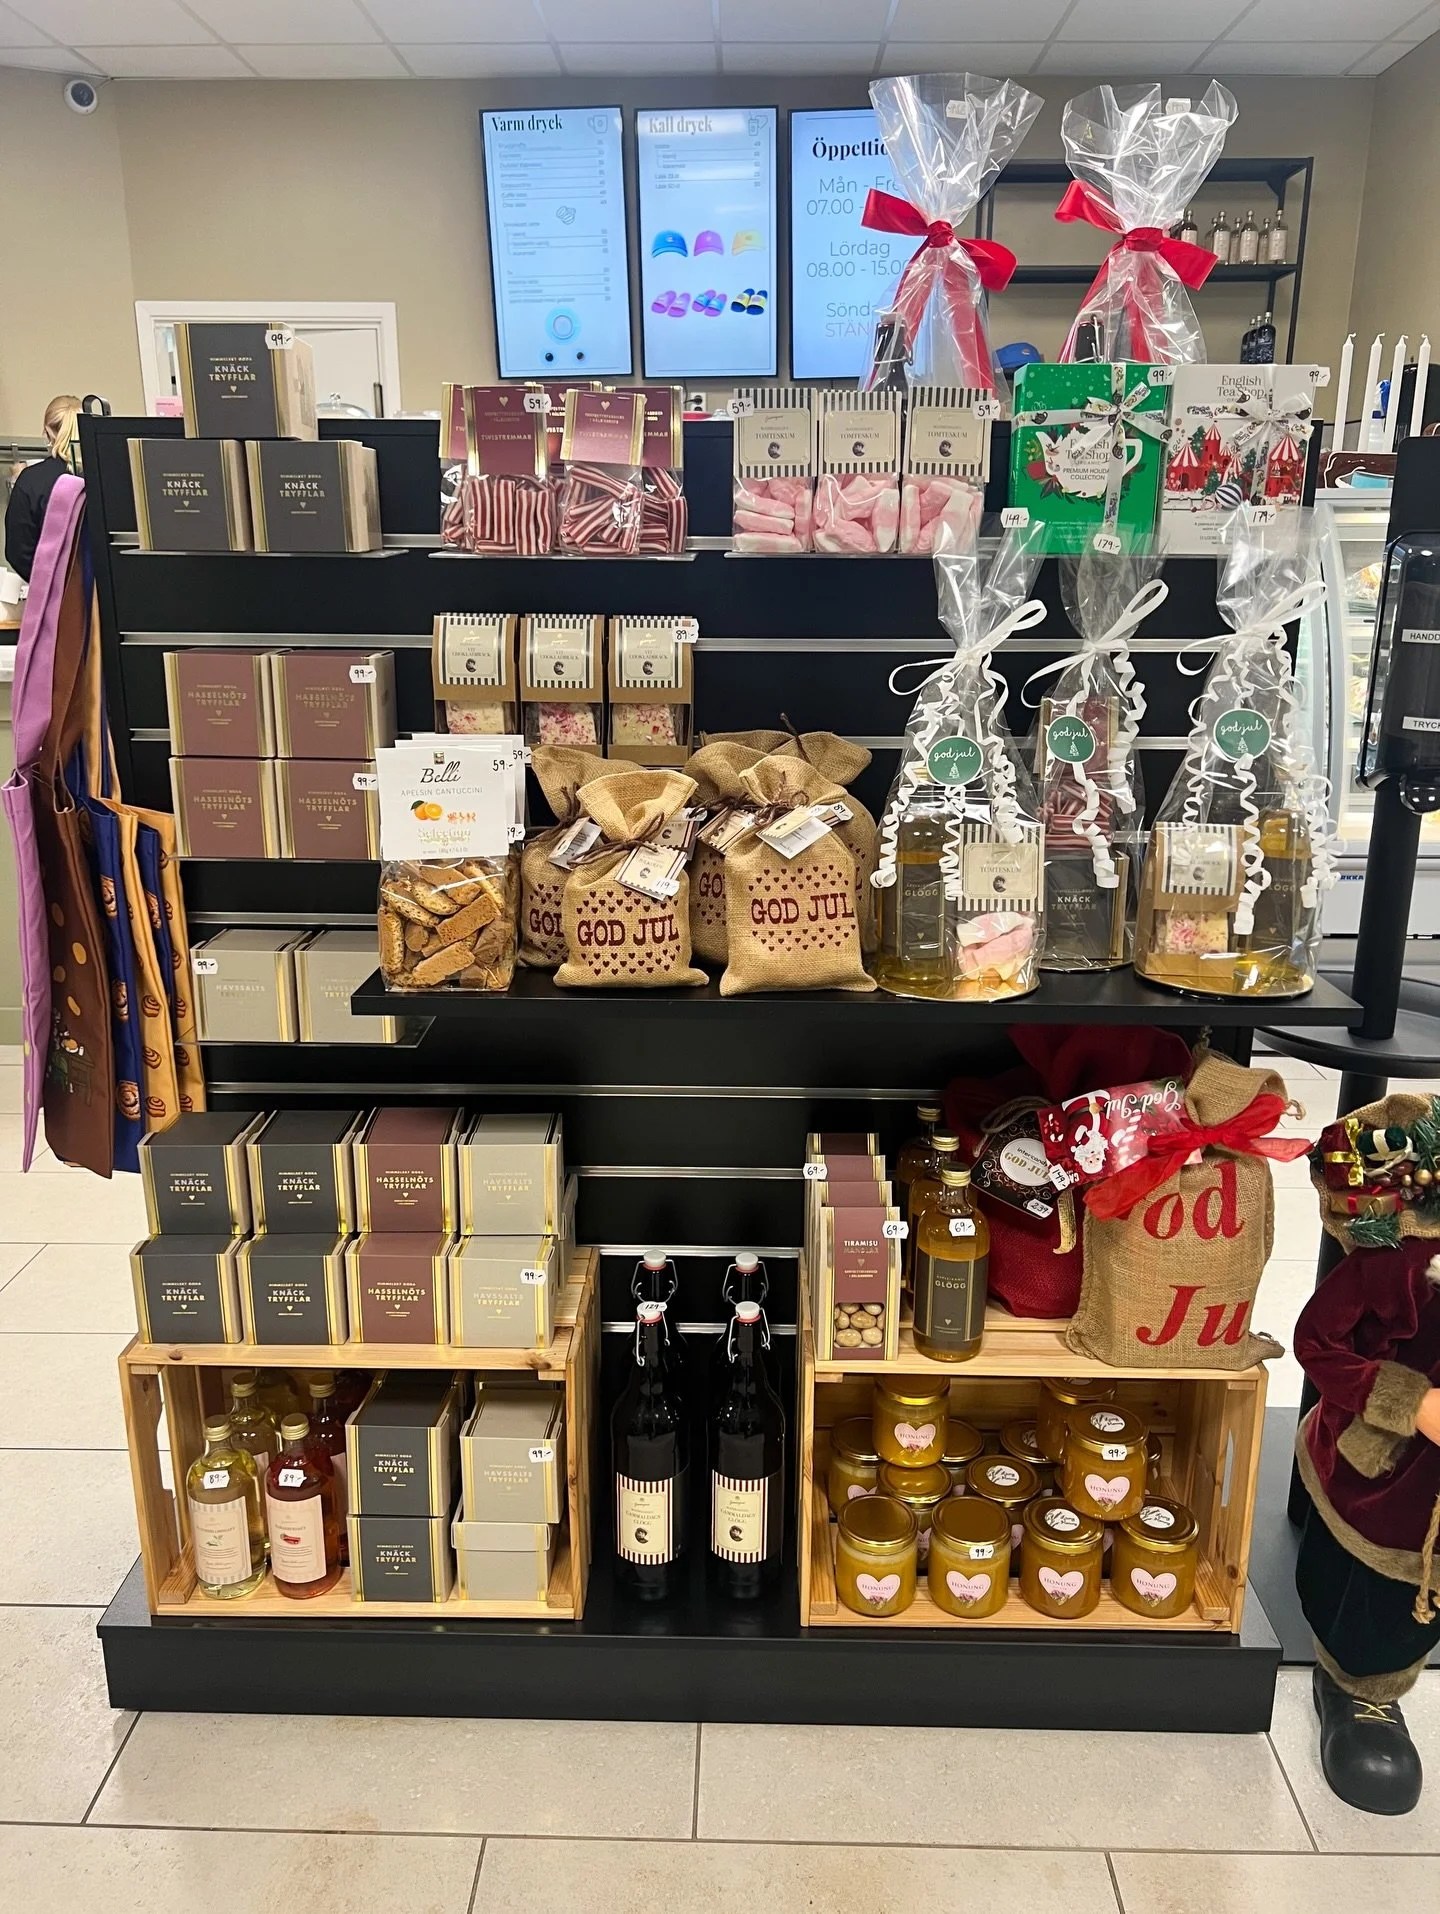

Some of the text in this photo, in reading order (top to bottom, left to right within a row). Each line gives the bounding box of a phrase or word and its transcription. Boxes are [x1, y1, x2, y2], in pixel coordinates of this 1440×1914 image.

[492, 114, 563, 133] Varm dryck
[649, 115, 712, 135] Kall dryck
[820, 175, 857, 193] Mån
[806, 198, 854, 215] 07.00
[830, 239, 890, 258] Lördag
[806, 261, 856, 277] 08.00
[826, 301, 878, 317] Sönd
[271, 333, 291, 345] 99:-
[214, 364, 249, 373] KNÄCK
[209, 373, 256, 381] TRYFFLAR
[1152, 370, 1172, 382] 99:-
[1309, 371, 1328, 383] 99:-
[1221, 375, 1262, 388] English
[1217, 387, 1236, 397] Tea
[529, 398, 549, 409] 59:-
[731, 402, 751, 414] 59:-
[978, 405, 998, 417] 59:-
[167, 479, 201, 488] KNÄCK
[284, 481, 319, 490] KNÄCK
[162, 488, 208, 496] TRYFFLAR
[279, 490, 325, 498] TRYFFLAR
[1006, 514, 1028, 525] 149:-
[1253, 510, 1276, 523] 179:-
[1098, 538, 1120, 550] 179:-
[354, 669, 373, 679] 99:-
[188, 691, 247, 699] HASSELNÖTS
[1220, 720, 1262, 735] god jul
[1053, 727, 1088, 740] god jul
[934, 746, 976, 761] god jul
[493, 760, 513, 771] 59:-
[420, 761, 461, 783] Belli
[357, 777, 376, 786] 99:-
[436, 787, 483, 795] CANTUCCINI
[193, 795, 252, 803] HASSELNÖTS
[299, 797, 357, 805] HASSELNÖTS
[1057, 894, 1091, 903] KNÄCK
[751, 893, 855, 925] GOD JUL
[577, 914, 679, 946] GOD JUL
[197, 961, 215, 970] 99:-
[216, 984, 265, 992] HAVSSALTS
[1004, 1152, 1027, 1168] GOD
[807, 1166, 825, 1176] 69:-
[174, 1177, 206, 1185] KNÄCK
[282, 1176, 314, 1184] KNÄCK
[376, 1175, 434, 1183] HASSELNÖTS
[1117, 1161, 1244, 1239] od
[886, 1224, 904, 1235] 69:-
[954, 1222, 973, 1232] 69:-
[525, 1271, 543, 1280] 99:-
[935, 1280, 966, 1289] GLÖGG
[166, 1286, 198, 1294] KNÄCK
[272, 1287, 305, 1295] KNÄCK
[368, 1286, 426, 1295] HASSELNÖTS
[532, 1449, 552, 1458] 99:-
[1108, 1449, 1125, 1458] 99:-
[1090, 1485, 1124, 1493] HONUNG
[380, 1549, 411, 1557] KNÄCK
[975, 1548, 994, 1557] 99:-
[862, 1583, 894, 1592] HONUNG
[951, 1581, 984, 1590] HONUNG
[1043, 1577, 1077, 1588] HONUNG
[1136, 1579, 1170, 1589] HONUNG
